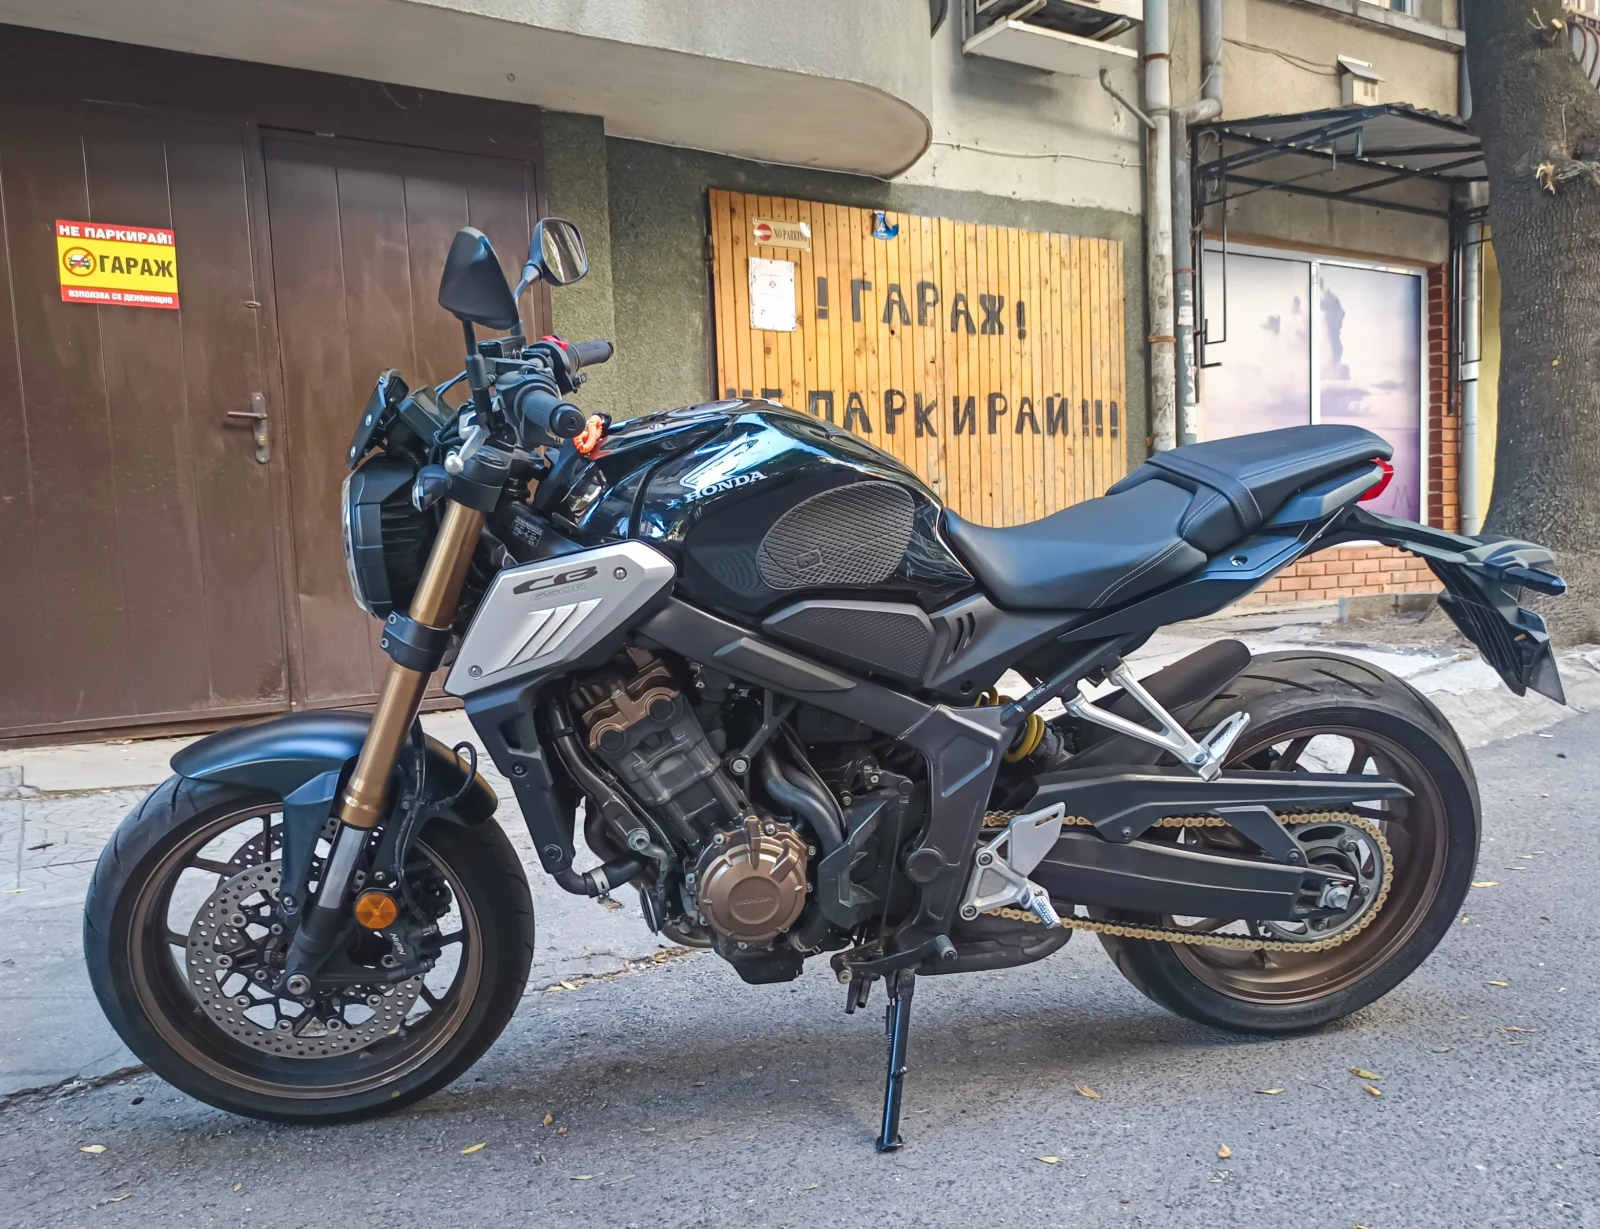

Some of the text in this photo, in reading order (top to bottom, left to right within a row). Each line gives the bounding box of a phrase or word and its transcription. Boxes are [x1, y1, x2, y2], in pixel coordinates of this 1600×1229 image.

[59, 225, 173, 245] НЕ ПАРКИРАЙ!
[774, 228, 782, 240] NO
[99, 254, 174, 278] ГАРАЖ
[68, 290, 173, 305] ИЗПОЛЗВА СЕ ДЕНОНОЩНО
[684, 470, 768, 503] HONDA
[513, 566, 598, 595] CB
